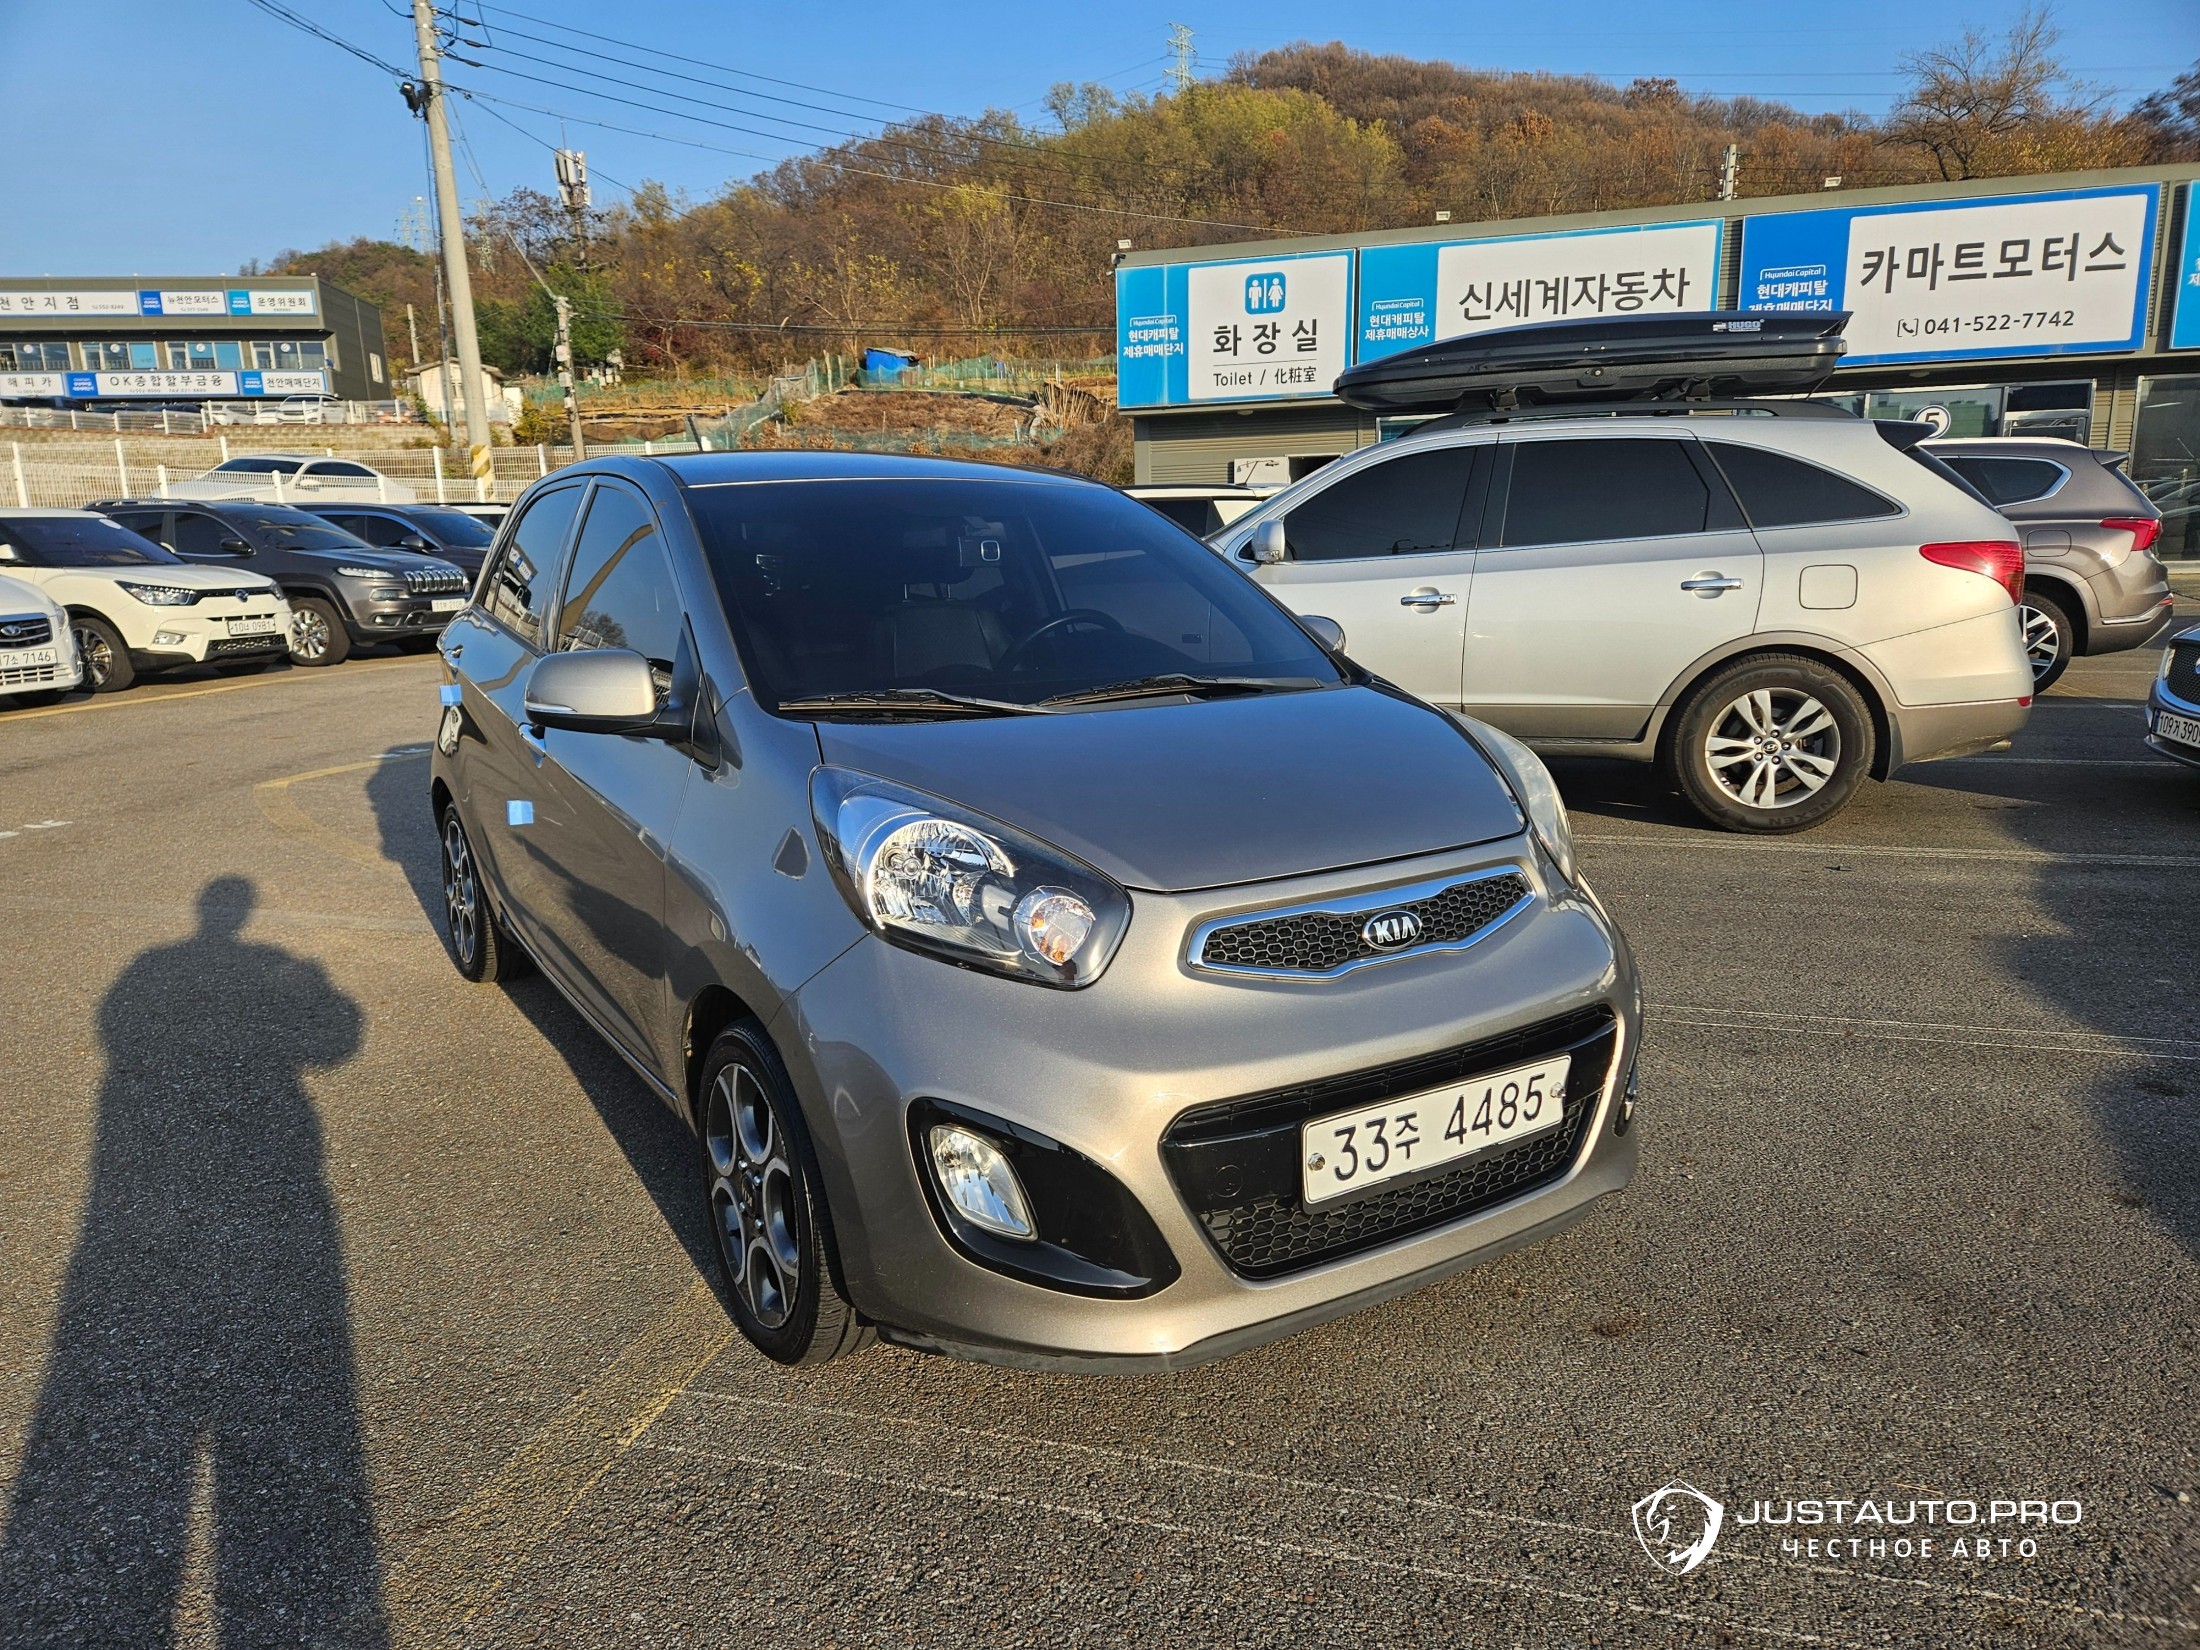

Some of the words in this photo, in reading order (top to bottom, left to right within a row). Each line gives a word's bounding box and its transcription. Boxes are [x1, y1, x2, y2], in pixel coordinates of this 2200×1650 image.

[1859, 232, 2127, 294] 카마트모터스
[1765, 269, 1795, 280] Hyundai
[1795, 267, 1821, 278] Capital
[1458, 267, 1691, 321] 신세계자동차
[1757, 279, 1828, 299] 현대캐피탈
[1376, 301, 1399, 310] Hyundai
[1400, 300, 1420, 309] Capital
[1369, 311, 1425, 327] 현대캐피탈
[1924, 310, 2075, 335] 041-522-7742
[1128, 326, 1179, 343] 현대캐피탈
[1212, 318, 1318, 357] 화장실
[1365, 325, 1430, 341] 제휴매매상사
[1123, 342, 1184, 358] 제휴매매단지
[266, 377, 320, 388] 천안매매단지
[1212, 371, 1253, 387] Toilet
[1274, 365, 1317, 385] 化粧室
[0, 655, 19, 666] 7소
[22, 651, 51, 664] 7146
[1768, 798, 1834, 826] NEXEN
[1373, 915, 1417, 944] KIA
[1334, 1111, 1421, 1182] 33주
[1444, 1072, 1546, 1145] 4485
